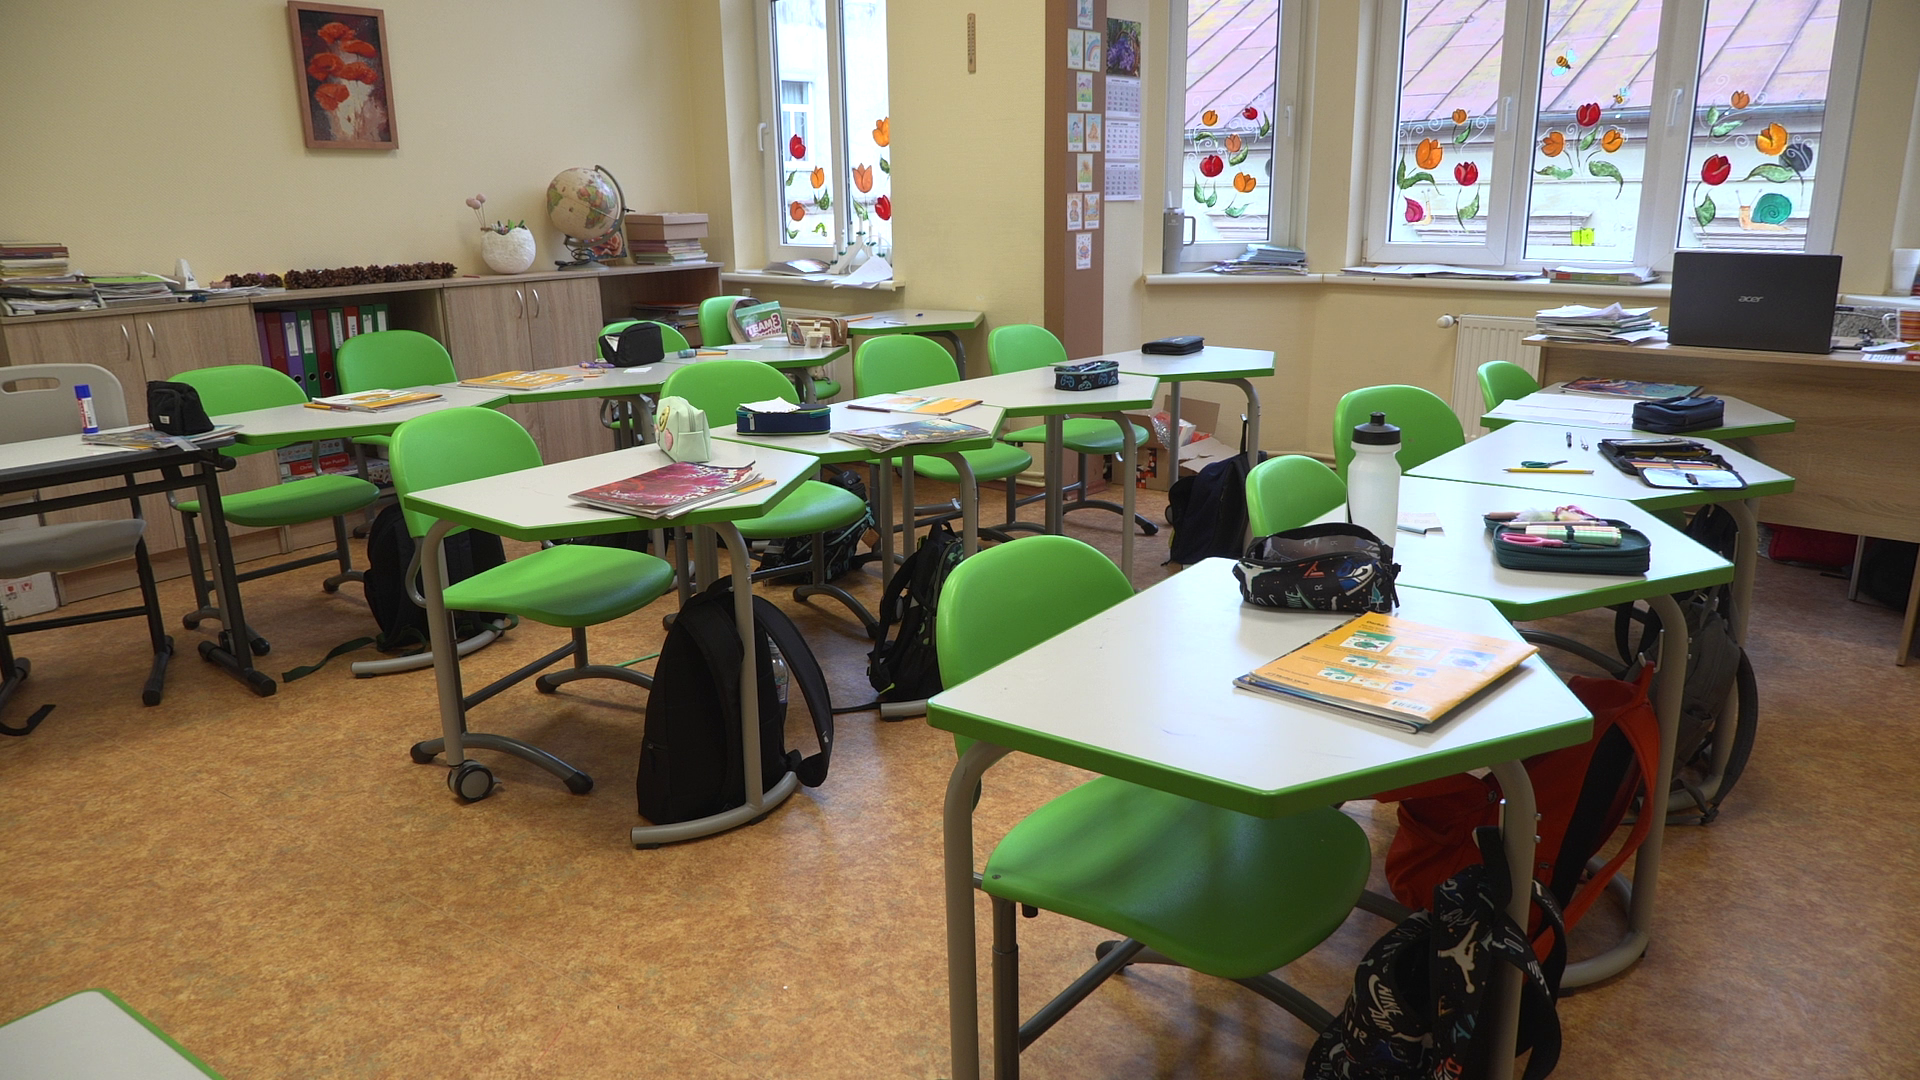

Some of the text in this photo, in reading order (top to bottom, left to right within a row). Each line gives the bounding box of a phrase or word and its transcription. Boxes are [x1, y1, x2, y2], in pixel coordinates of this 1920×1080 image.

[1738, 295, 1764, 303] acer
[746, 313, 782, 336] TEAM 3
[1377, 982, 1404, 1018] NIKE
